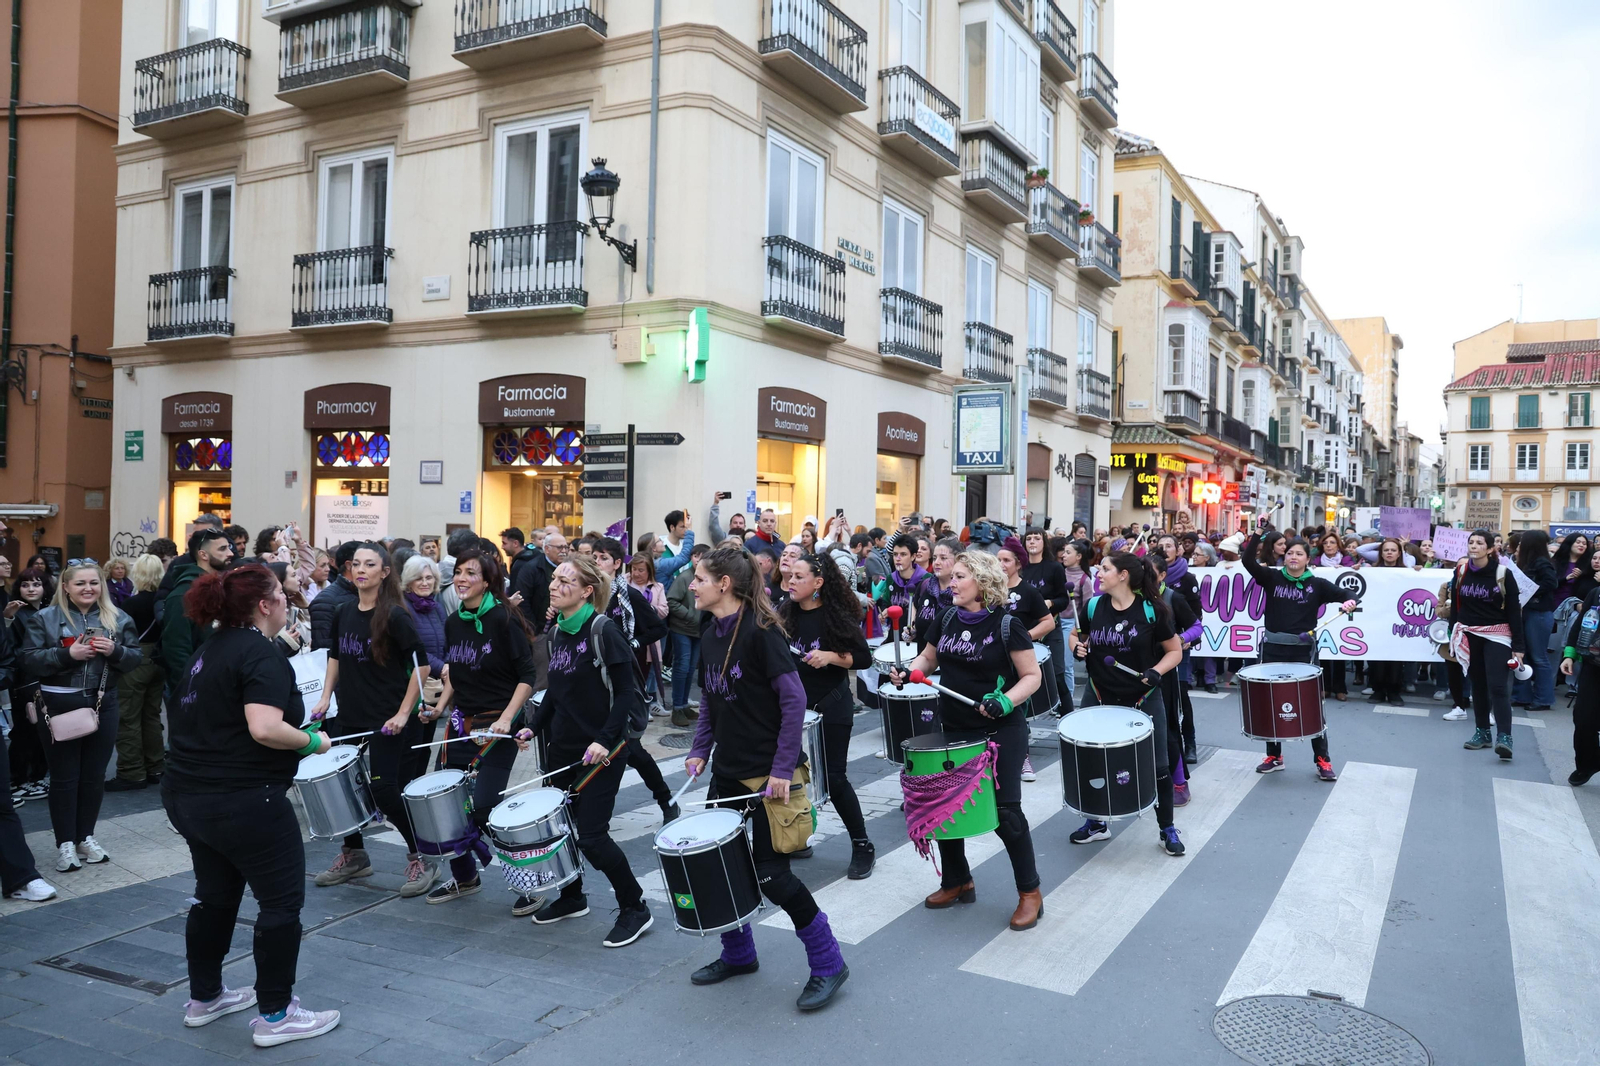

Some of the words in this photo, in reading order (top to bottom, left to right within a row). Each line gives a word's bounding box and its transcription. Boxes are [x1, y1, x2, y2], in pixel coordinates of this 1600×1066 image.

[838, 236, 861, 255] PLAZA
[865, 249, 874, 261] DE
[836, 250, 846, 261] LA
[849, 256, 876, 275] MERCED
[498, 384, 567, 401] Farmacia
[174, 400, 220, 415] Farmacia
[316, 400, 377, 416] Pharmacy
[503, 406, 556, 417] Bustamante
[770, 395, 816, 419] Farmacia
[179, 420, 198, 428] desde
[199, 418, 214, 428] 1739
[775, 417, 809, 432] Bustamante
[885, 425, 918, 443] Apotheke
[963, 452, 998, 464] TAXI
[1157, 453, 1187, 473] Restaurante
[1148, 484, 1158, 495] de
[299, 682, 319, 692] E-HOP
